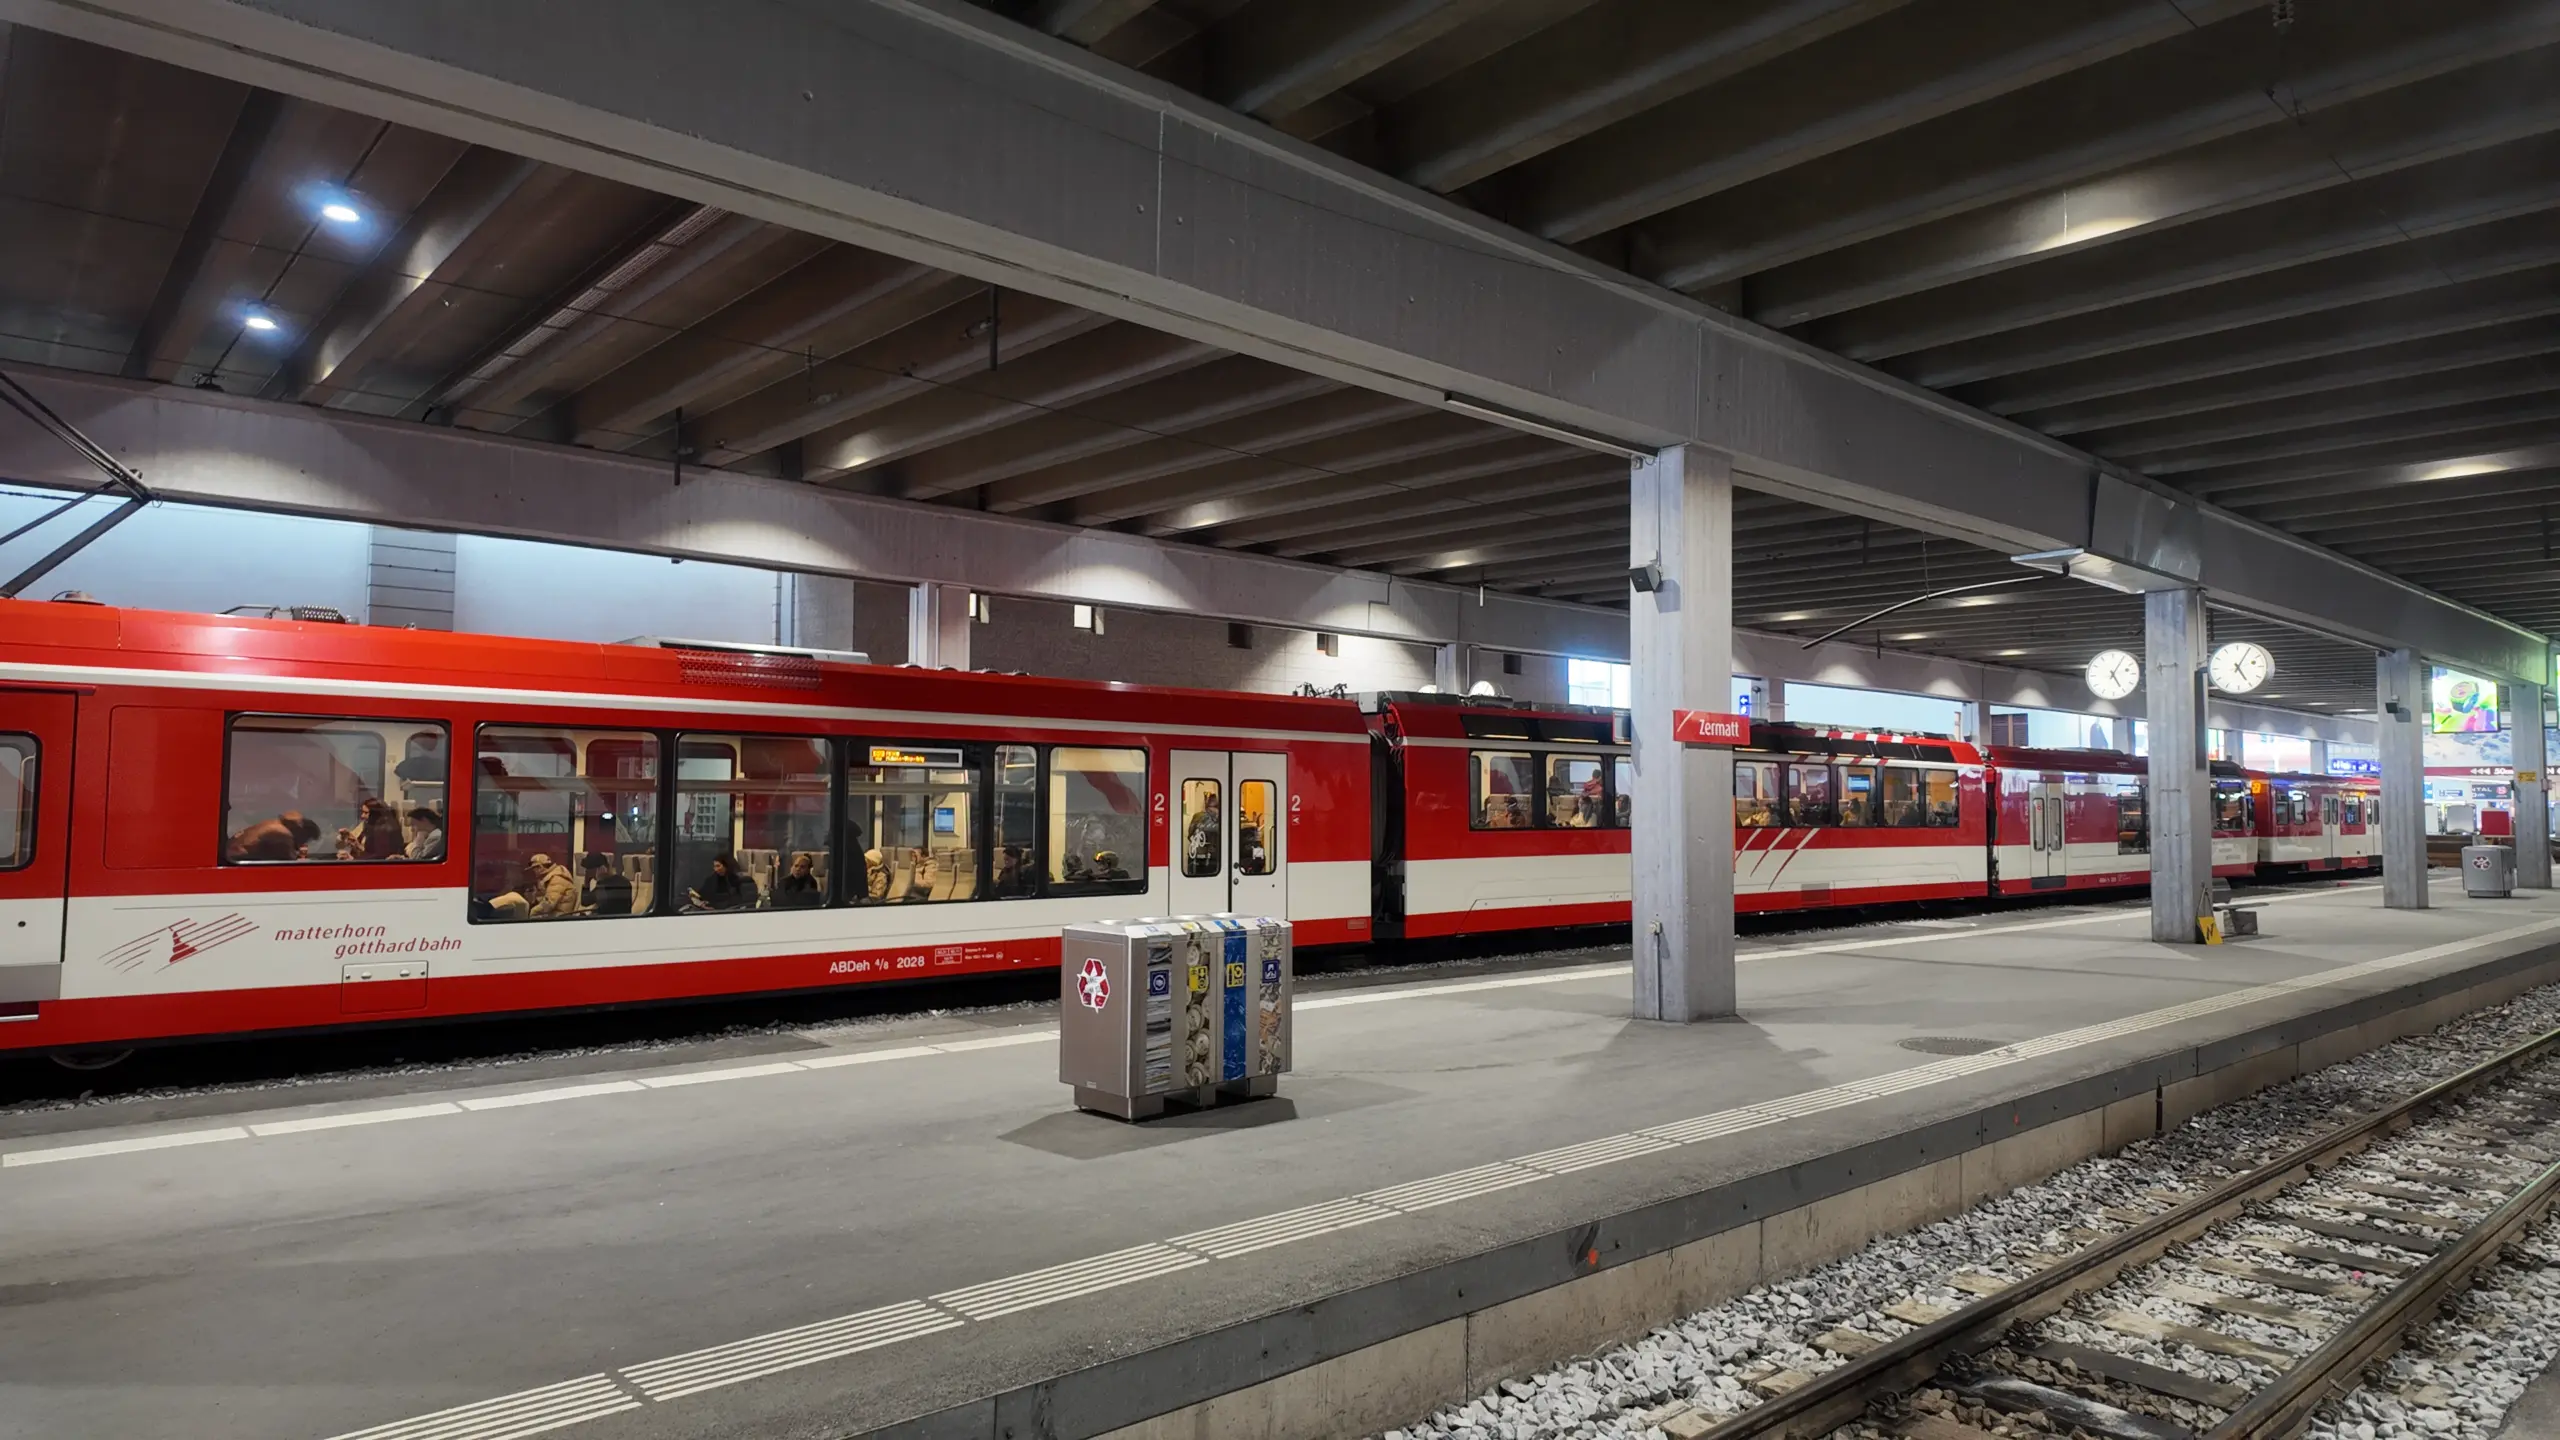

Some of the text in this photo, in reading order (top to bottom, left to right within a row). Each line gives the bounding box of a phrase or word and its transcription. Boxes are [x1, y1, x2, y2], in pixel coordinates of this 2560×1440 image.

[1699, 719, 1740, 737] Zermatt
[1154, 793, 1165, 811] 2
[1291, 795, 1301, 811] 2
[274, 923, 386, 941] matterhorn
[829, 958, 871, 974] ABDeh
[874, 958, 889, 971] 4/8
[896, 955, 925, 969] 2028
